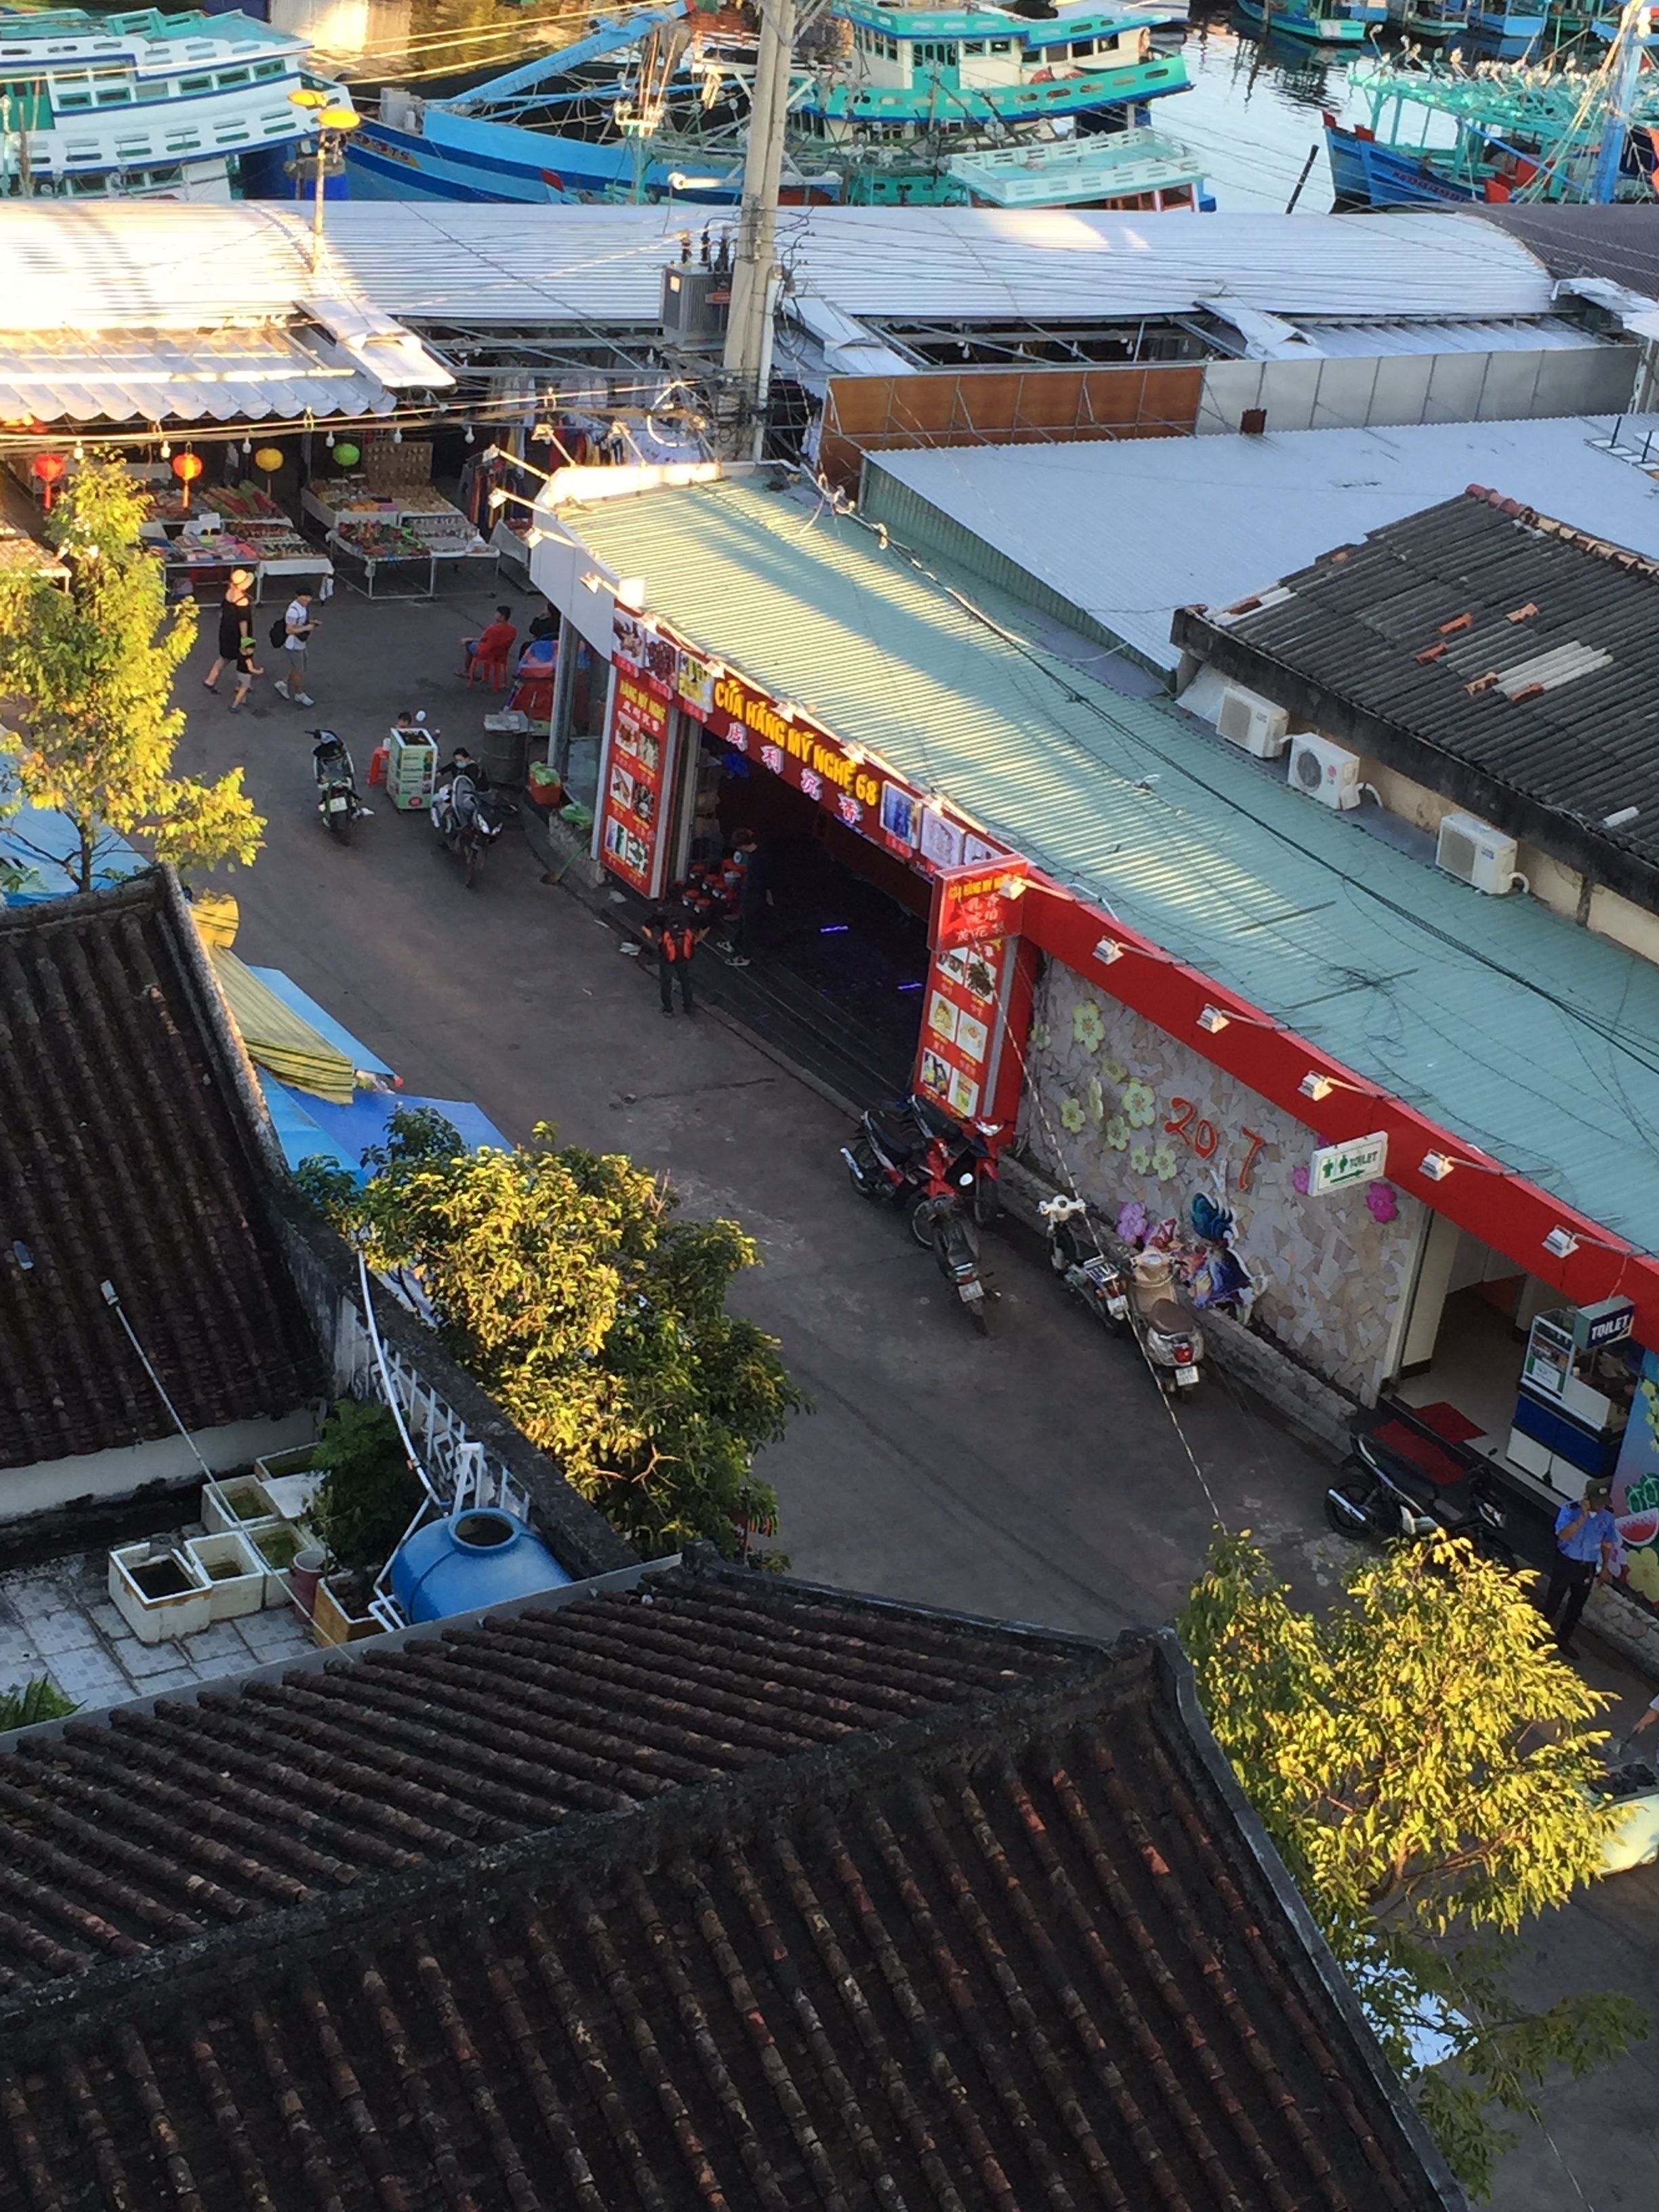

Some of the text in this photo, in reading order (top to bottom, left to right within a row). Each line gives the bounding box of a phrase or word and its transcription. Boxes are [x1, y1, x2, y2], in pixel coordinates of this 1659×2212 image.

[855, 774, 880, 806] 68
[1349, 1151, 1378, 1169] TOILET
[1591, 1313, 1631, 1341] TOILET
